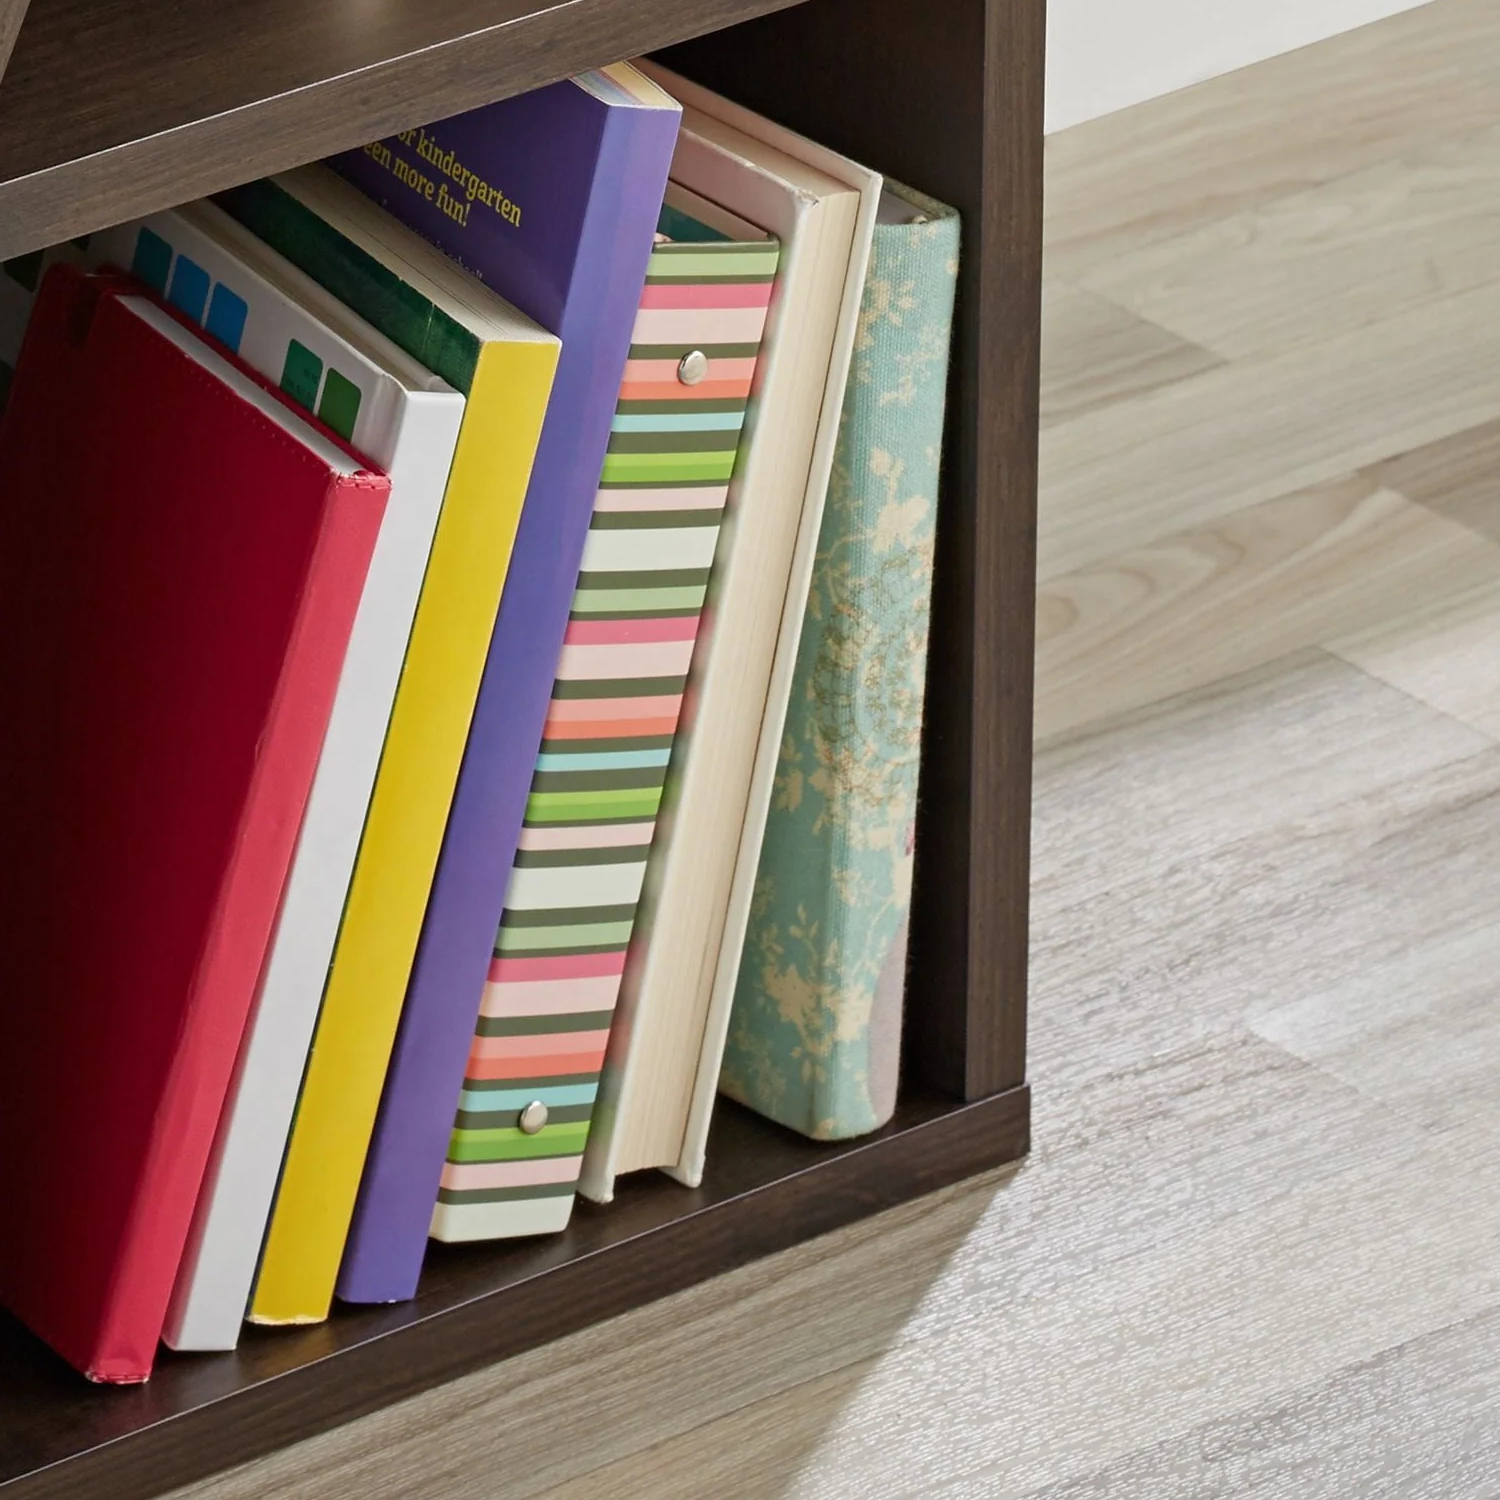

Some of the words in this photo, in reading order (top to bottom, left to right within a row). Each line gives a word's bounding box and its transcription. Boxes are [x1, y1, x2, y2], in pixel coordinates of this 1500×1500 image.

[392, 156, 435, 201] more
[435, 183, 472, 228] fun!
[416, 128, 522, 228] kindergarten
